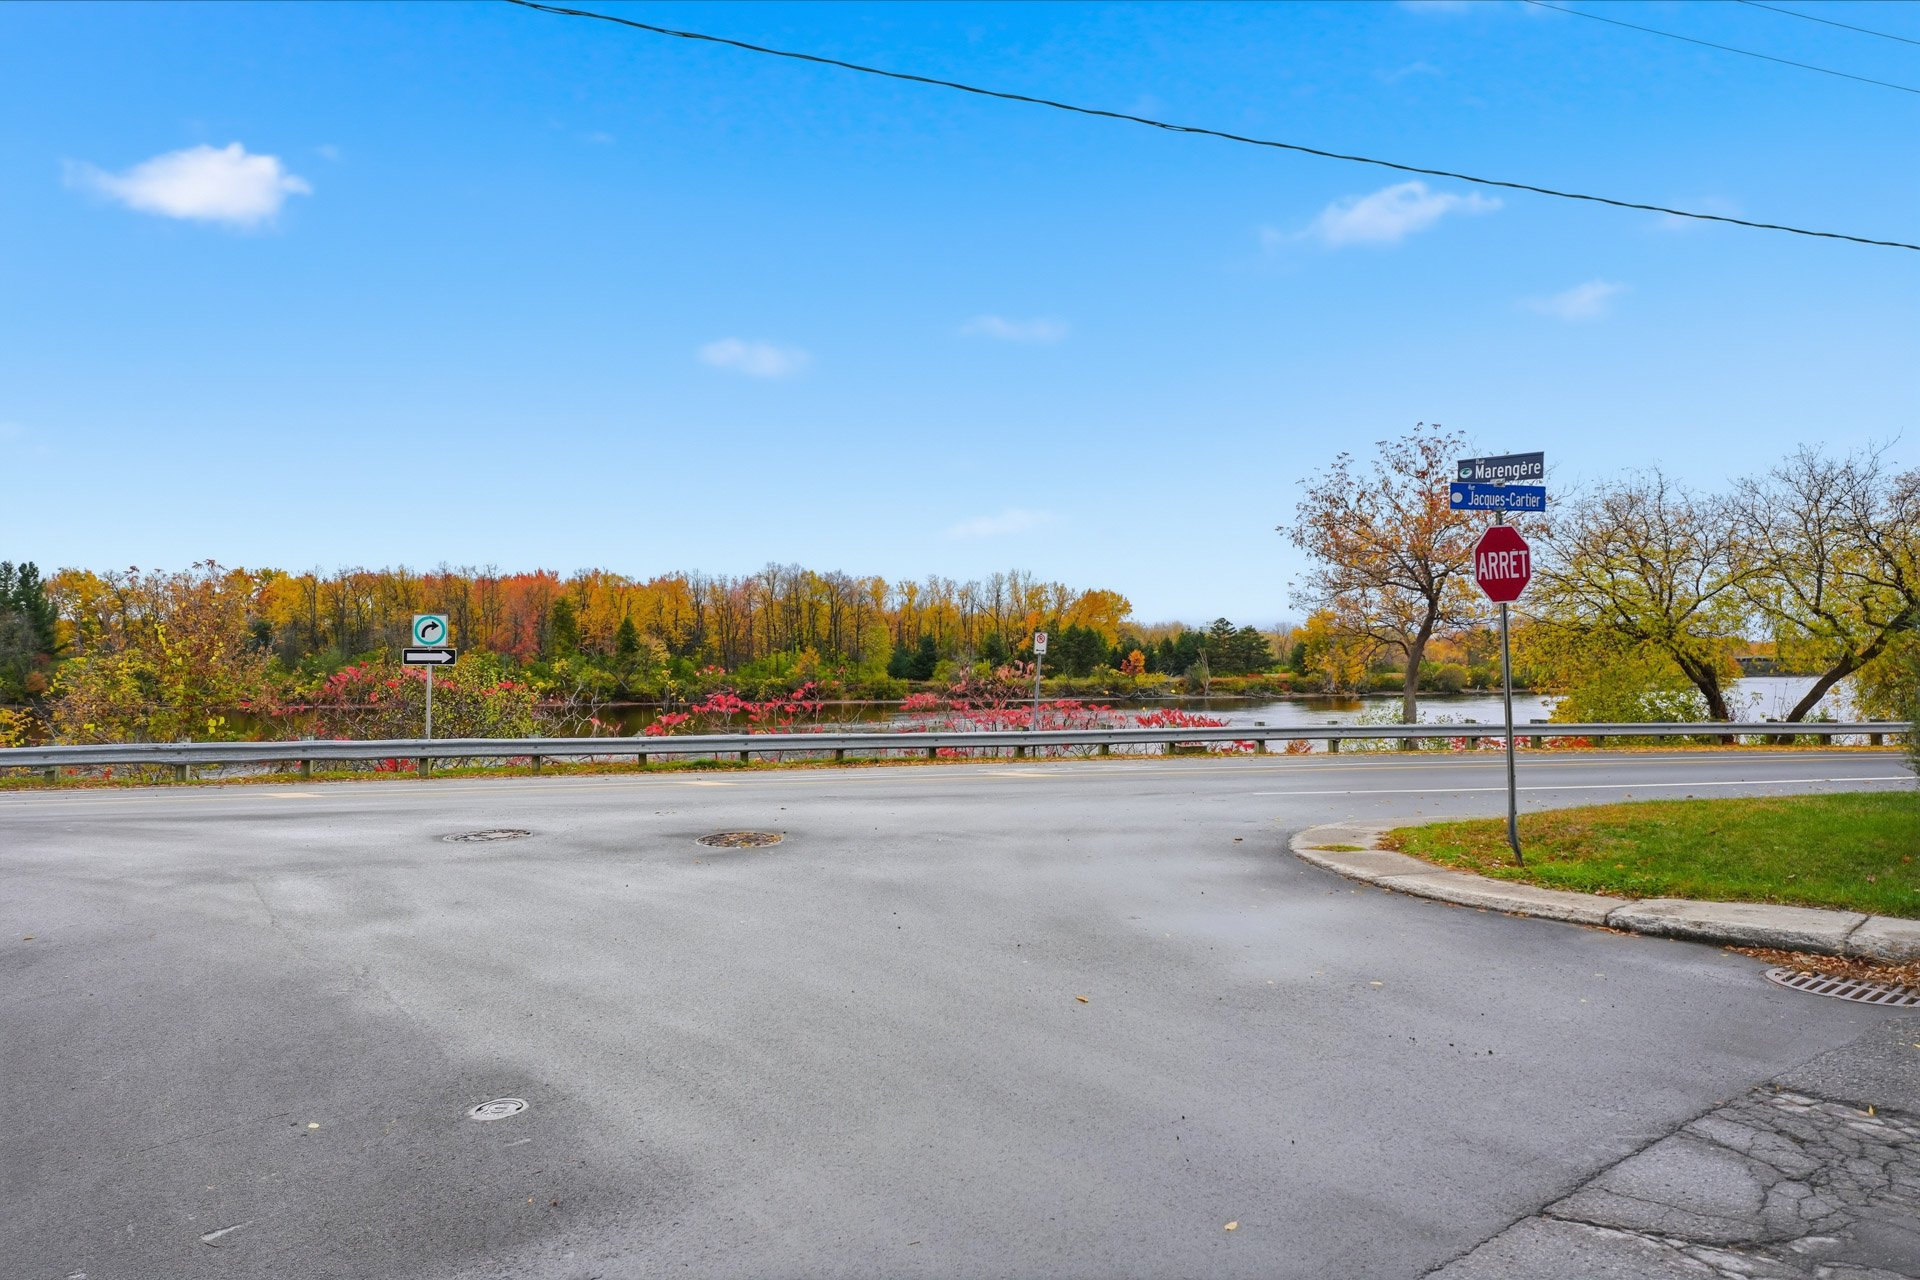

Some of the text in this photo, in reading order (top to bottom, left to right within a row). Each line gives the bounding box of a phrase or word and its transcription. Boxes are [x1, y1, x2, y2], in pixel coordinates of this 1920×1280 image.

[1475, 461, 1541, 480] Marengère
[1468, 491, 1540, 509] Jacques-Cartier
[1478, 548, 1528, 580] ARRÊT
